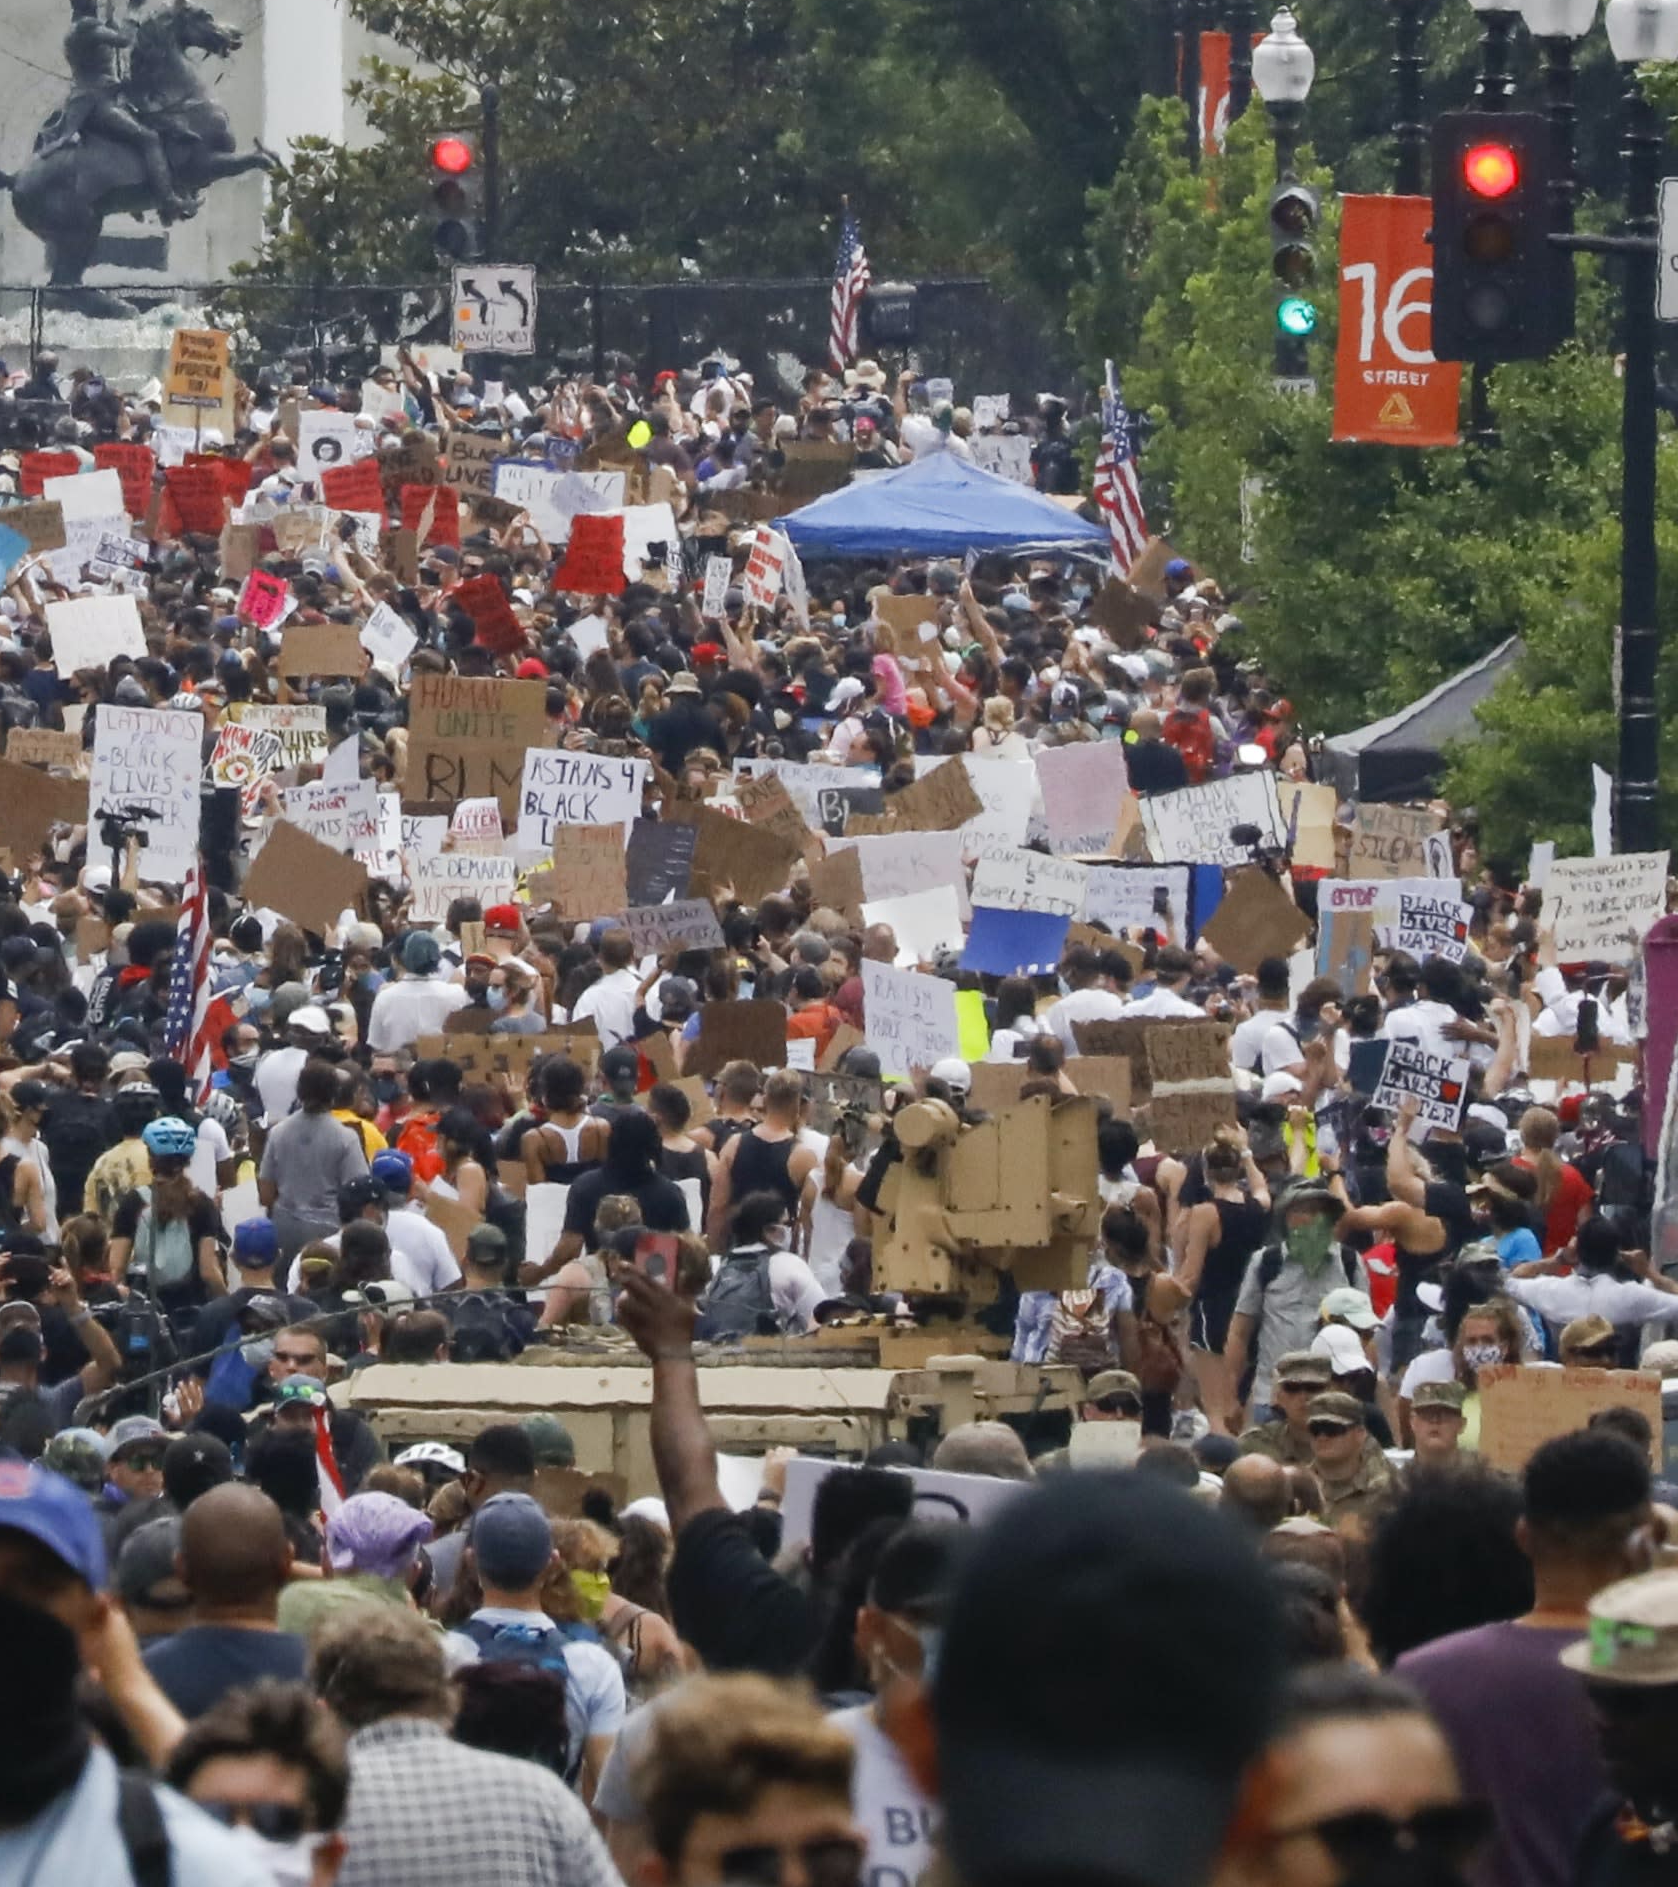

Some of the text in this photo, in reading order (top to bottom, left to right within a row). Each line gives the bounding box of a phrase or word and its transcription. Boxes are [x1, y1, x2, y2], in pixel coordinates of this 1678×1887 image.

[1343, 262, 1437, 363] 16
[1362, 369, 1430, 387] STREET
[445, 468, 492, 489] LIVE
[106, 710, 198, 740] LATINOS
[435, 715, 518, 739] UNITE
[108, 746, 176, 774] BLACK
[108, 772, 173, 795] LIVES
[530, 756, 636, 793] ASIANS 4
[524, 790, 599, 822] BLACK
[417, 856, 514, 880] WE DEMAND
[1401, 893, 1462, 920] BLACK
[1581, 896, 1622, 913] MORE
[1400, 912, 1457, 937] LIVES
[1398, 933, 1463, 962] MATTER
[1390, 1043, 1454, 1078] BLACK
[1383, 1068, 1442, 1099] LIVES
